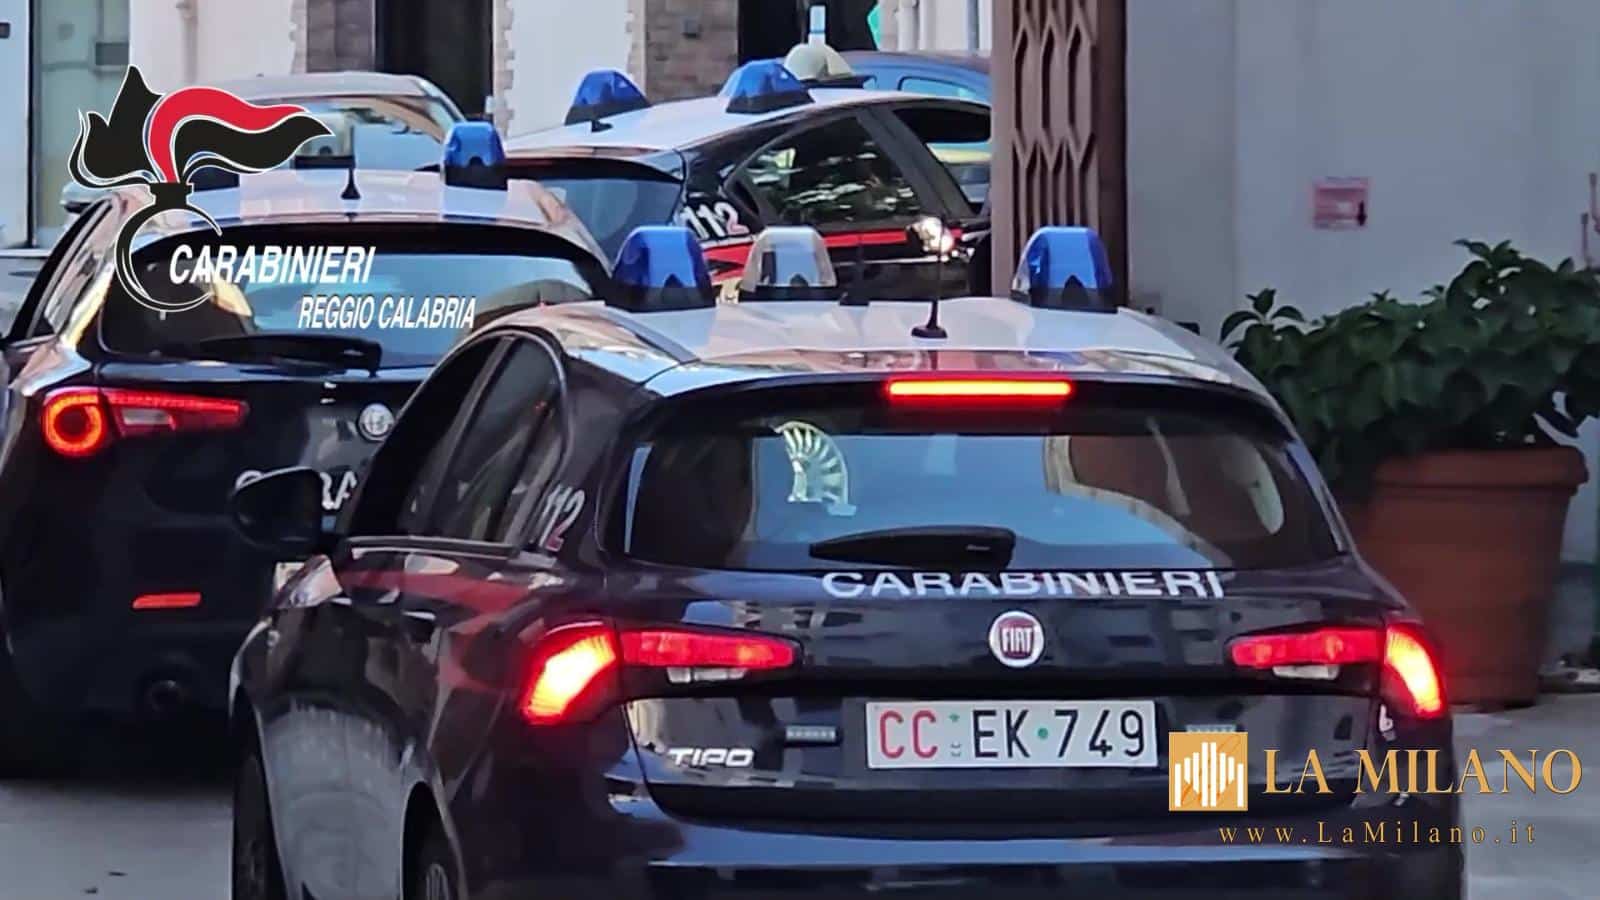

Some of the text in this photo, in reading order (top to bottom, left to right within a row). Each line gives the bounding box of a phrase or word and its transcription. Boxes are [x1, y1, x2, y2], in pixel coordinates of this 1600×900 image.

[680, 202, 750, 239] 112
[540, 485, 585, 551] 112
[823, 571, 1224, 598] CARABINIERI
[1002, 627, 1033, 653] FIAT
[879, 709, 1145, 759] CC EK 749
[668, 748, 754, 767] TIPO
